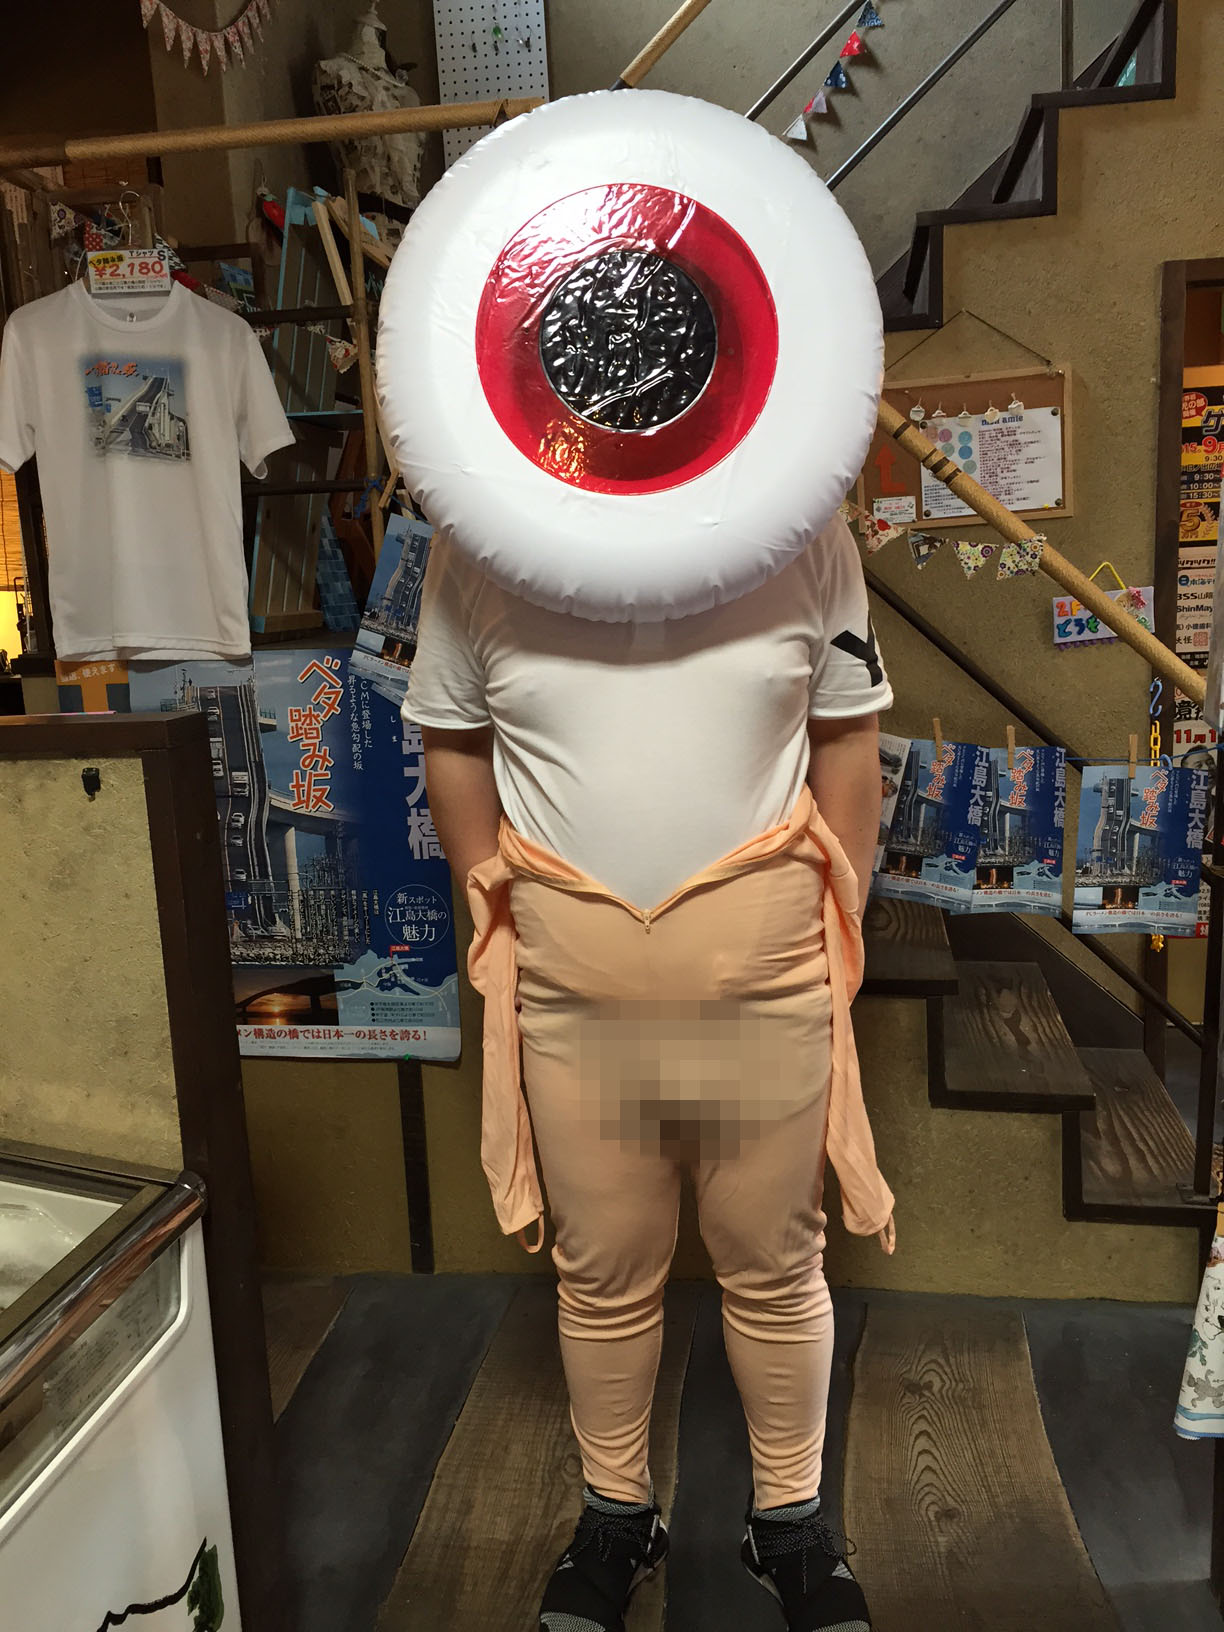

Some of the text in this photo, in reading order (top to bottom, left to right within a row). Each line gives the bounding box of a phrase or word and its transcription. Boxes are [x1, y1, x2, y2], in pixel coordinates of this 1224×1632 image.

[95, 261, 164, 278] ¥2,180
[157, 250, 166, 261] S
[289, 655, 343, 813] ベタ踏み坂
[926, 743, 956, 801] ベタ踏み坂
[967, 745, 990, 827] 江島大橋
[1009, 749, 1035, 808] ベタ踏み坂
[1140, 769, 1169, 828] ベタ踏み坂
[1186, 769, 1209, 850] 江島大橋
[388, 907, 447, 923] 江島大橋の
[396, 892, 437, 904] 新スポット
[402, 924, 436, 942] 魅力
